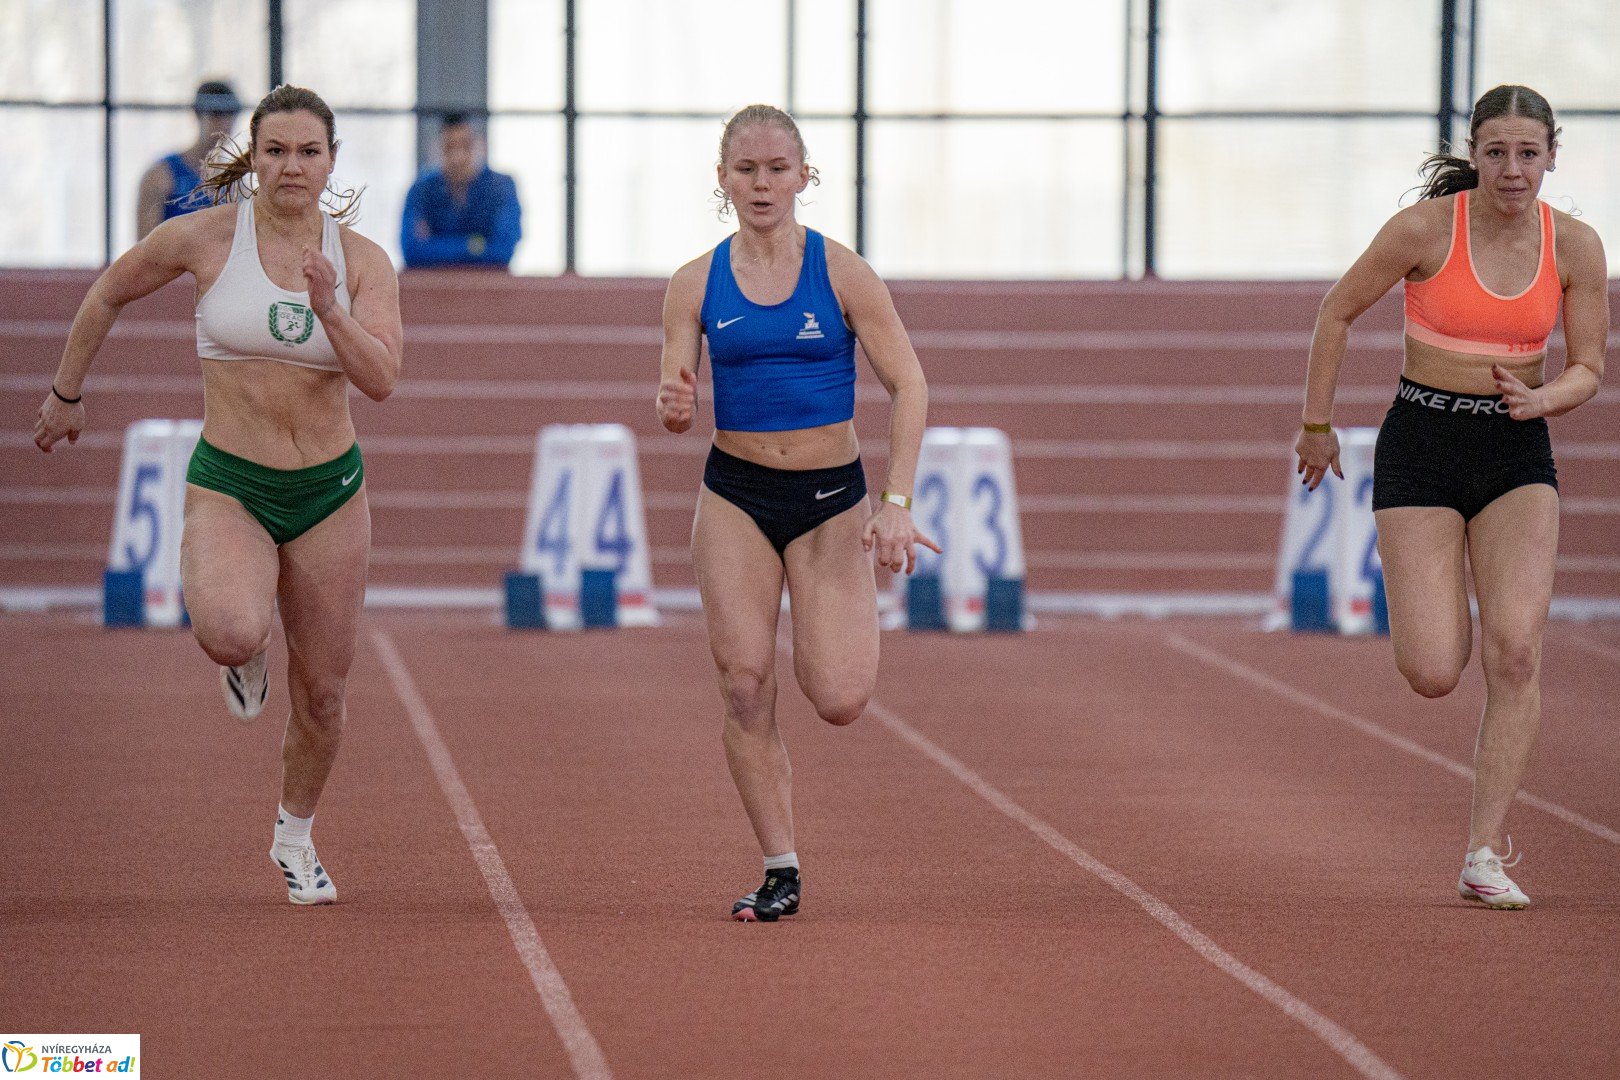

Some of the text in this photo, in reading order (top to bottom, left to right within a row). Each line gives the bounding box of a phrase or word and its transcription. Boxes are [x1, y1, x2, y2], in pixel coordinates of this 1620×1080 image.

[1398, 382, 1510, 415] NIKE PRO
[127, 463, 163, 571] 5
[536, 467, 573, 576] 4
[594, 466, 634, 574] 4
[916, 471, 949, 575] 3
[971, 472, 1007, 577] 3
[1300, 476, 1334, 570] 2
